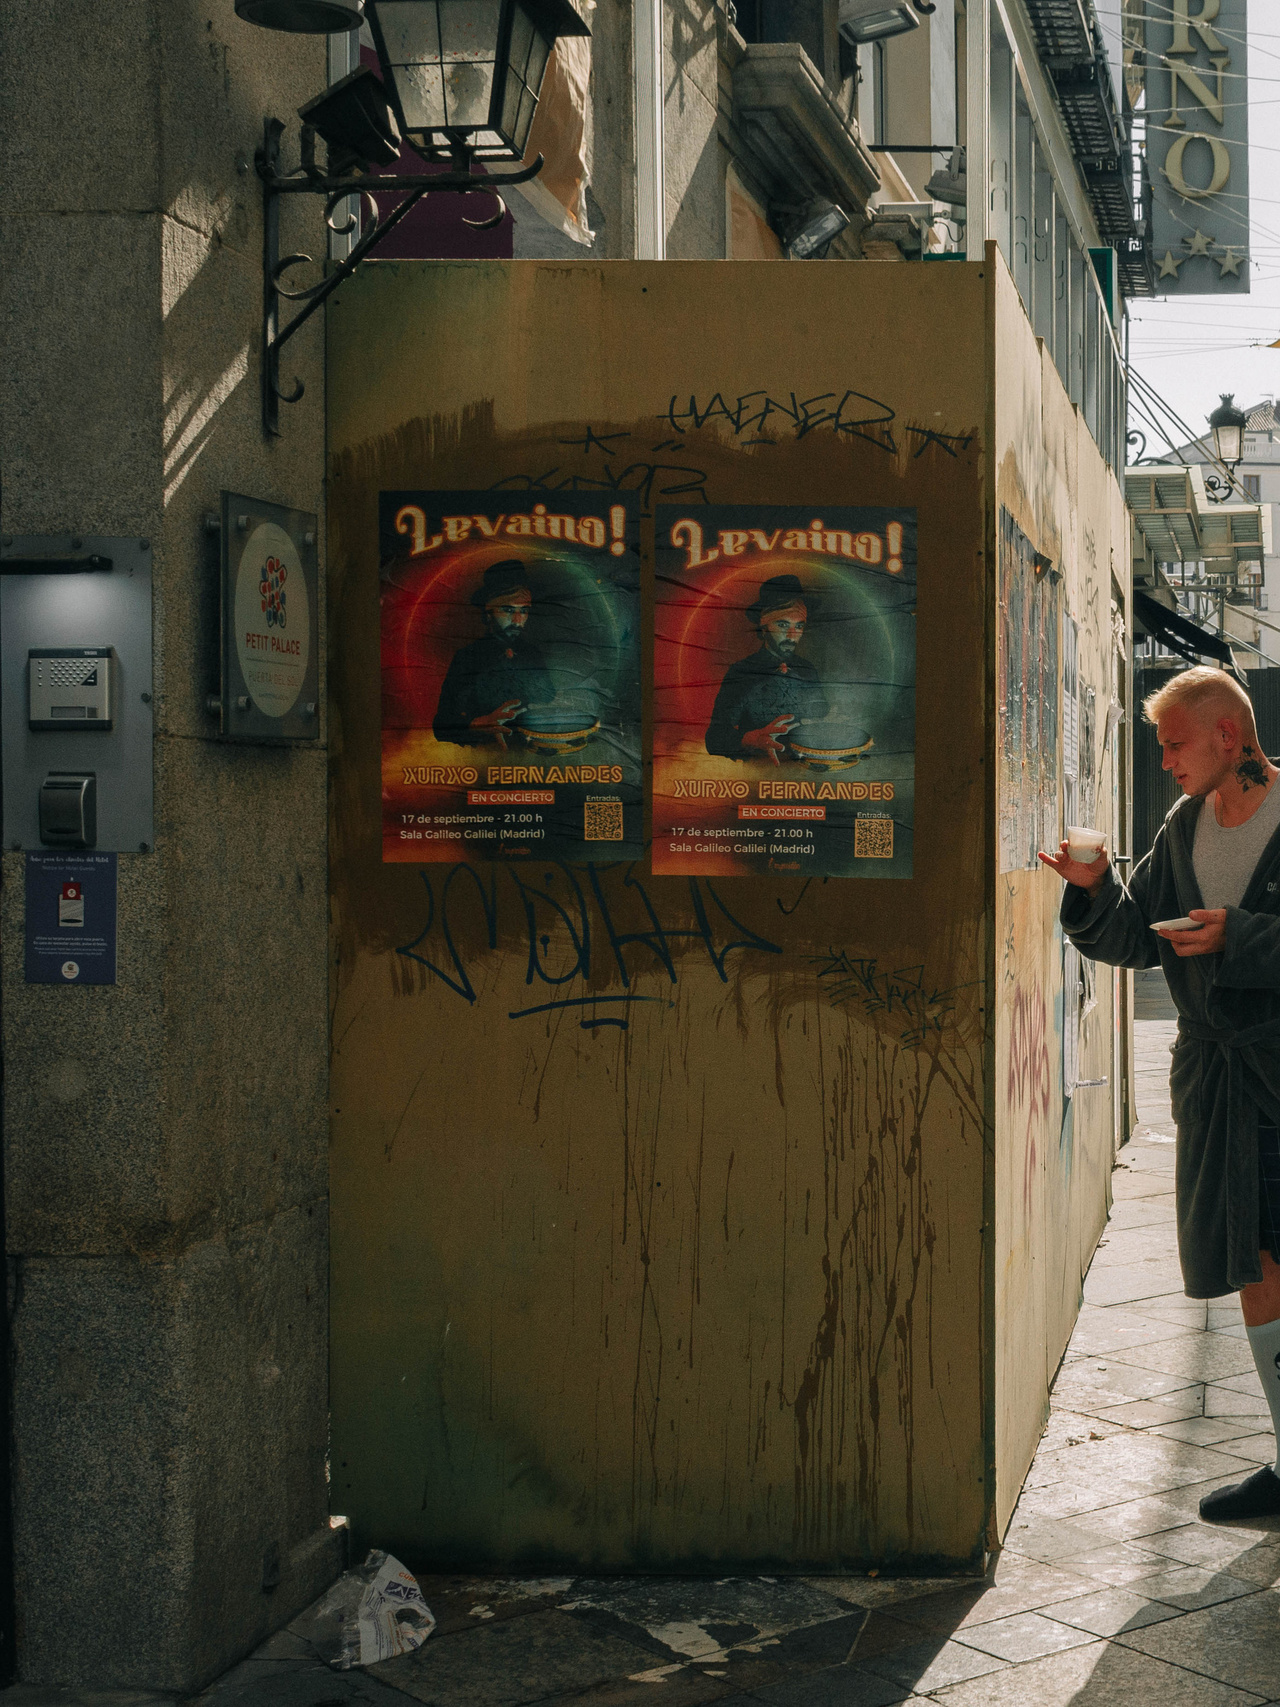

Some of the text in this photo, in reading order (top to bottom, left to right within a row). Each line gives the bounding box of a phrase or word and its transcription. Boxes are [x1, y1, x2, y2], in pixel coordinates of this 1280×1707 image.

[395, 502, 627, 557] Levaino!
[670, 517, 903, 574] Levaino!
[246, 632, 301, 655] PETIT PALACE
[248, 670, 273, 685] PUERTA
[274, 673, 286, 686] DEL
[402, 765, 623, 785] XURXO FERNANDES
[673, 780, 895, 801] XURXO FERNANDES
[471, 792, 553, 803] EN CONCIERTO
[742, 808, 825, 818] EN CONCIERTO
[856, 811, 892, 819] Entradas:
[401, 814, 415, 824] 17
[417, 814, 431, 824] de
[433, 814, 494, 826] septiembre
[503, 814, 533, 823] 21.00
[535, 814, 543, 823] h
[400, 829, 545, 840] Sala Galileo Galilei (Madrid)
[671, 828, 685, 837] 17
[687, 828, 701, 837] de
[703, 828, 765, 839] septiembre
[774, 828, 803, 838] 21.00
[805, 828, 814, 838] h
[670, 843, 815, 855] Sala Galileo Galilei (Madrid)
